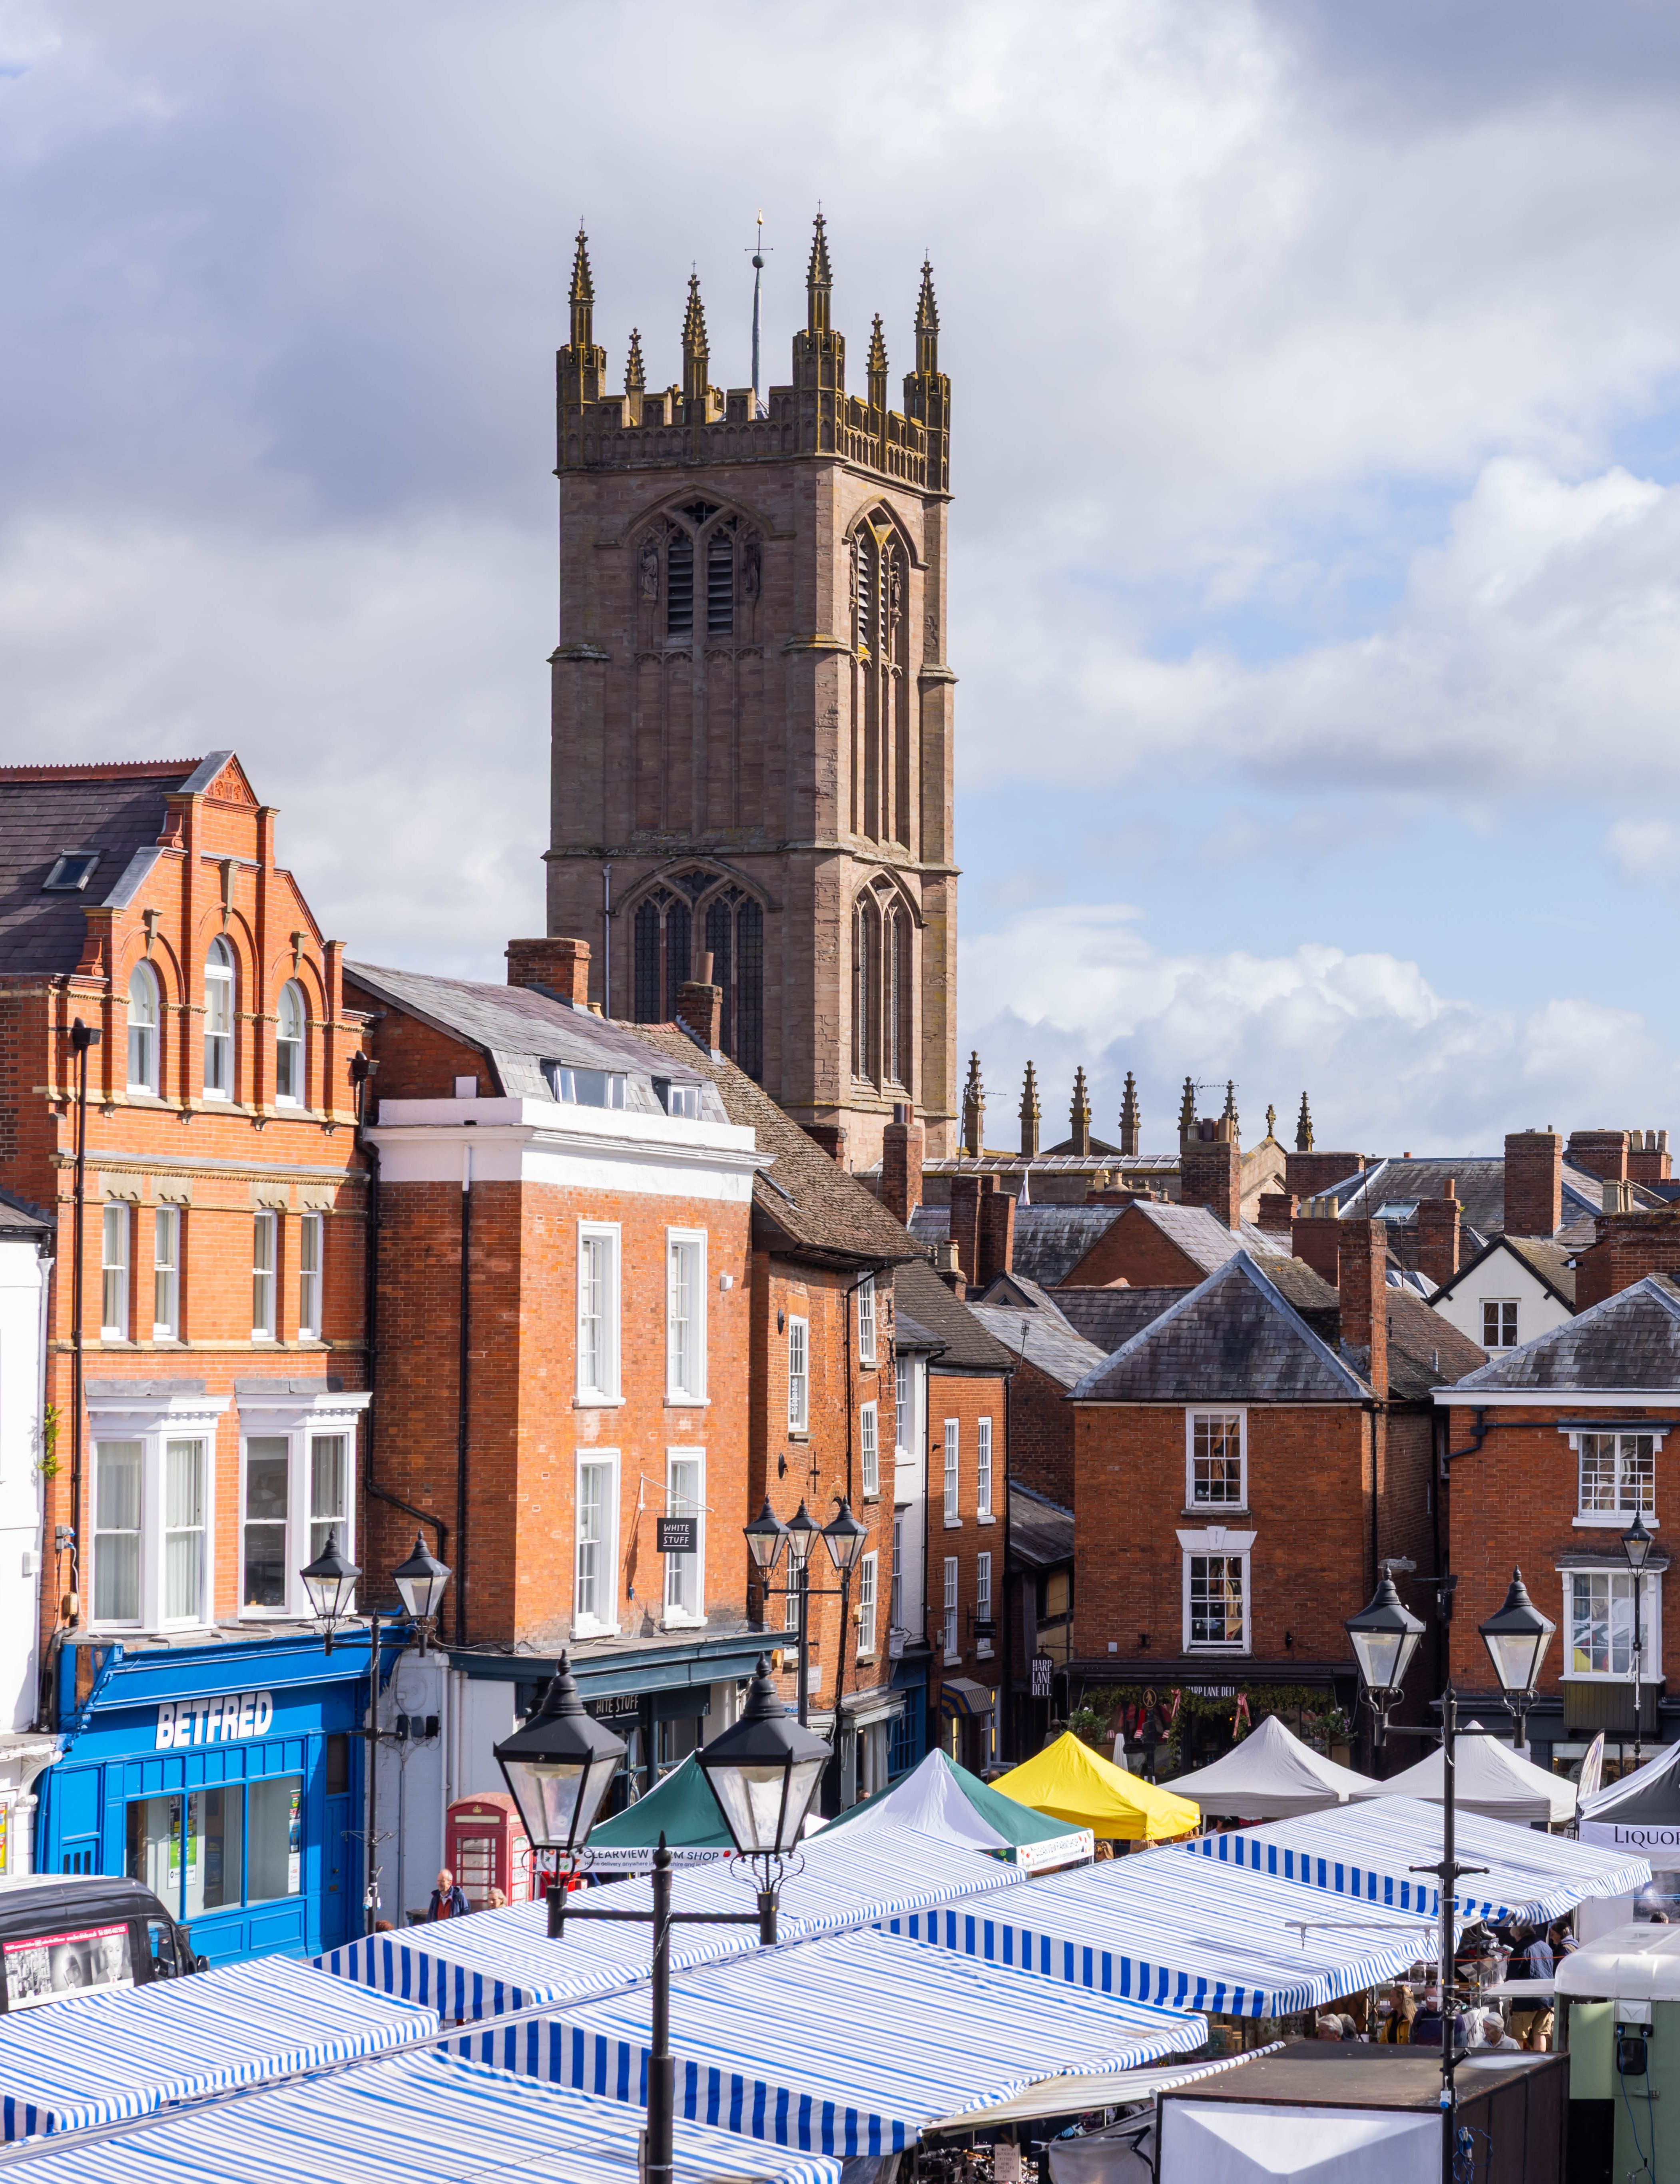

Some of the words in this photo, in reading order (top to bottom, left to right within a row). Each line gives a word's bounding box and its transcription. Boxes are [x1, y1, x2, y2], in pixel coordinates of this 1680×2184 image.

[1032, 1660, 1052, 1671] HARP
[1032, 1672, 1051, 1684] LANE
[1032, 1684, 1052, 1696] DELI.
[1204, 1686, 1219, 1696] LANE
[596, 1698, 614, 1714] HITE
[616, 1695, 639, 1712] STUFF
[155, 1691, 273, 1750] BETFRED
[584, 1849, 649, 1859] CLEARVIEW
[652, 1849, 684, 1859] FM
[687, 1851, 719, 1861] SHOP
